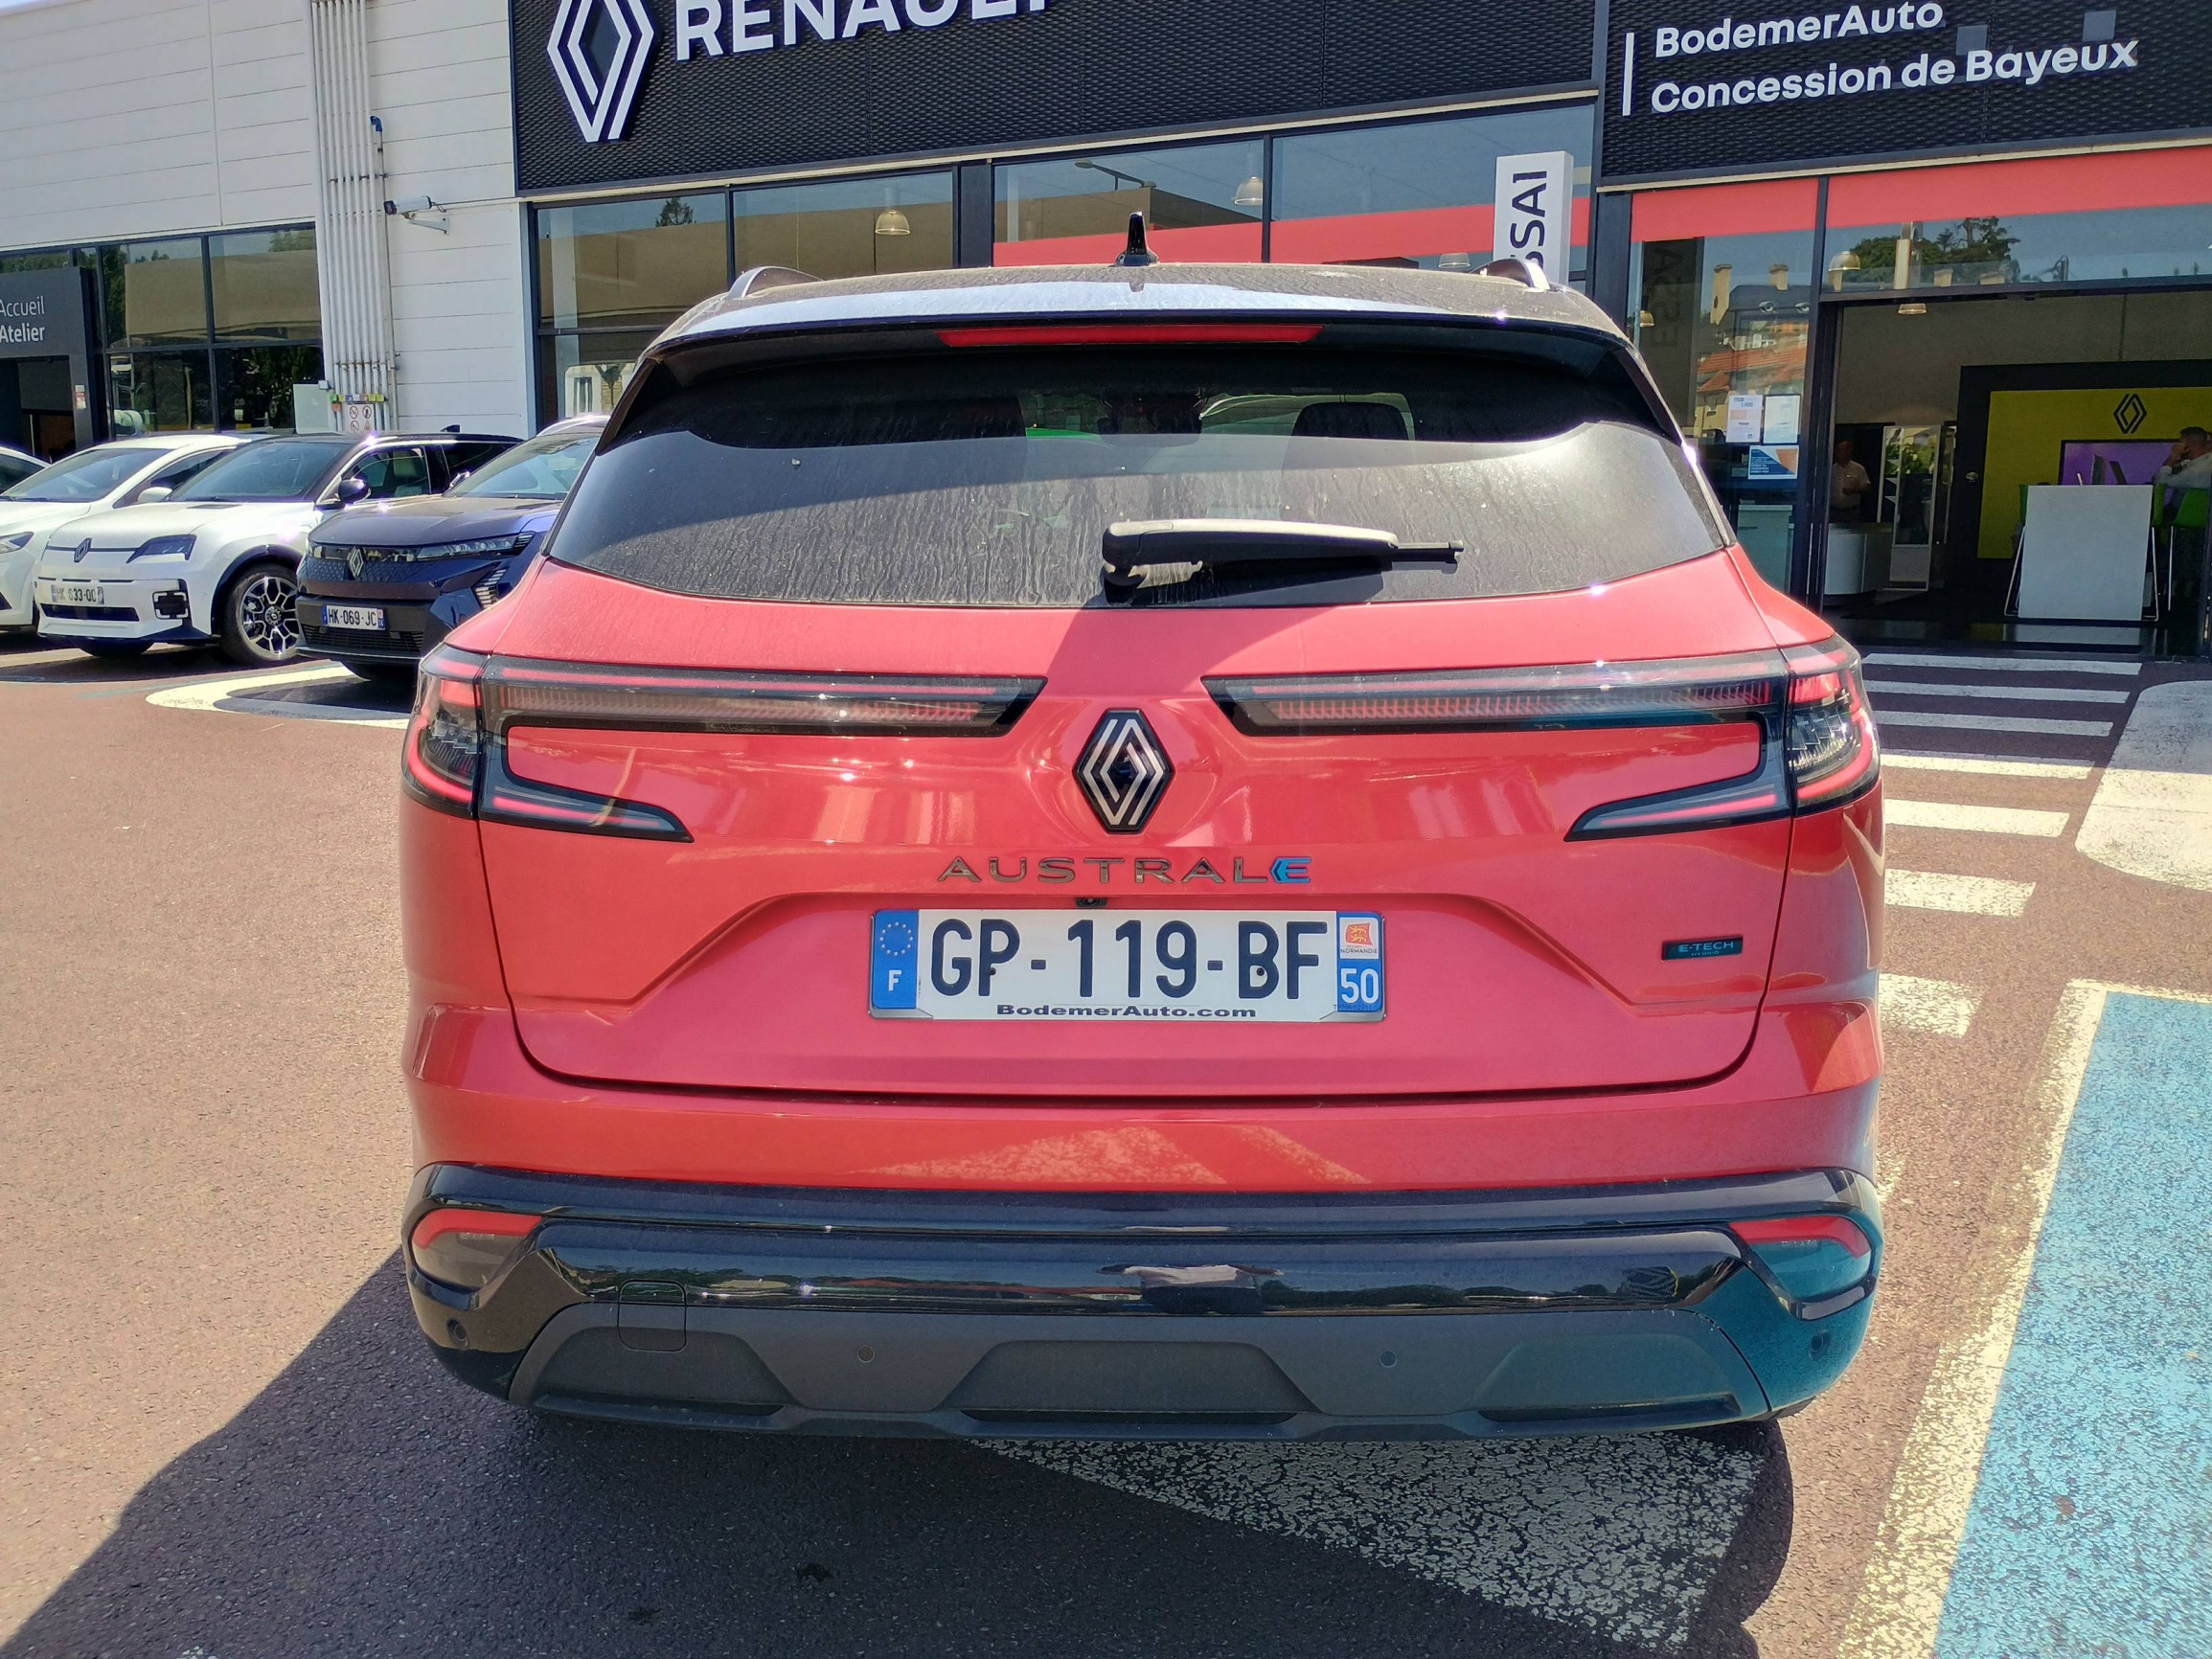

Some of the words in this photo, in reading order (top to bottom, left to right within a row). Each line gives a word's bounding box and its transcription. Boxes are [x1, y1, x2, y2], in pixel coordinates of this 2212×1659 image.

[676, 0, 1045, 60] RENAU
[1655, 2, 1944, 57] BodemerAuto
[1652, 63, 1892, 112] Concession
[1901, 54, 1956, 87] de
[1966, 40, 2140, 85] Bayeux
[0, 322, 45, 343] Atelier
[328, 609, 376, 625] HK-069-JC
[888, 969, 902, 991] F
[931, 919, 1328, 999] GP-119-BF
[1677, 941, 1734, 952] E-TECH
[1341, 968, 1379, 1004] 50
[997, 1004, 1256, 1018] BodemerAuto.com
